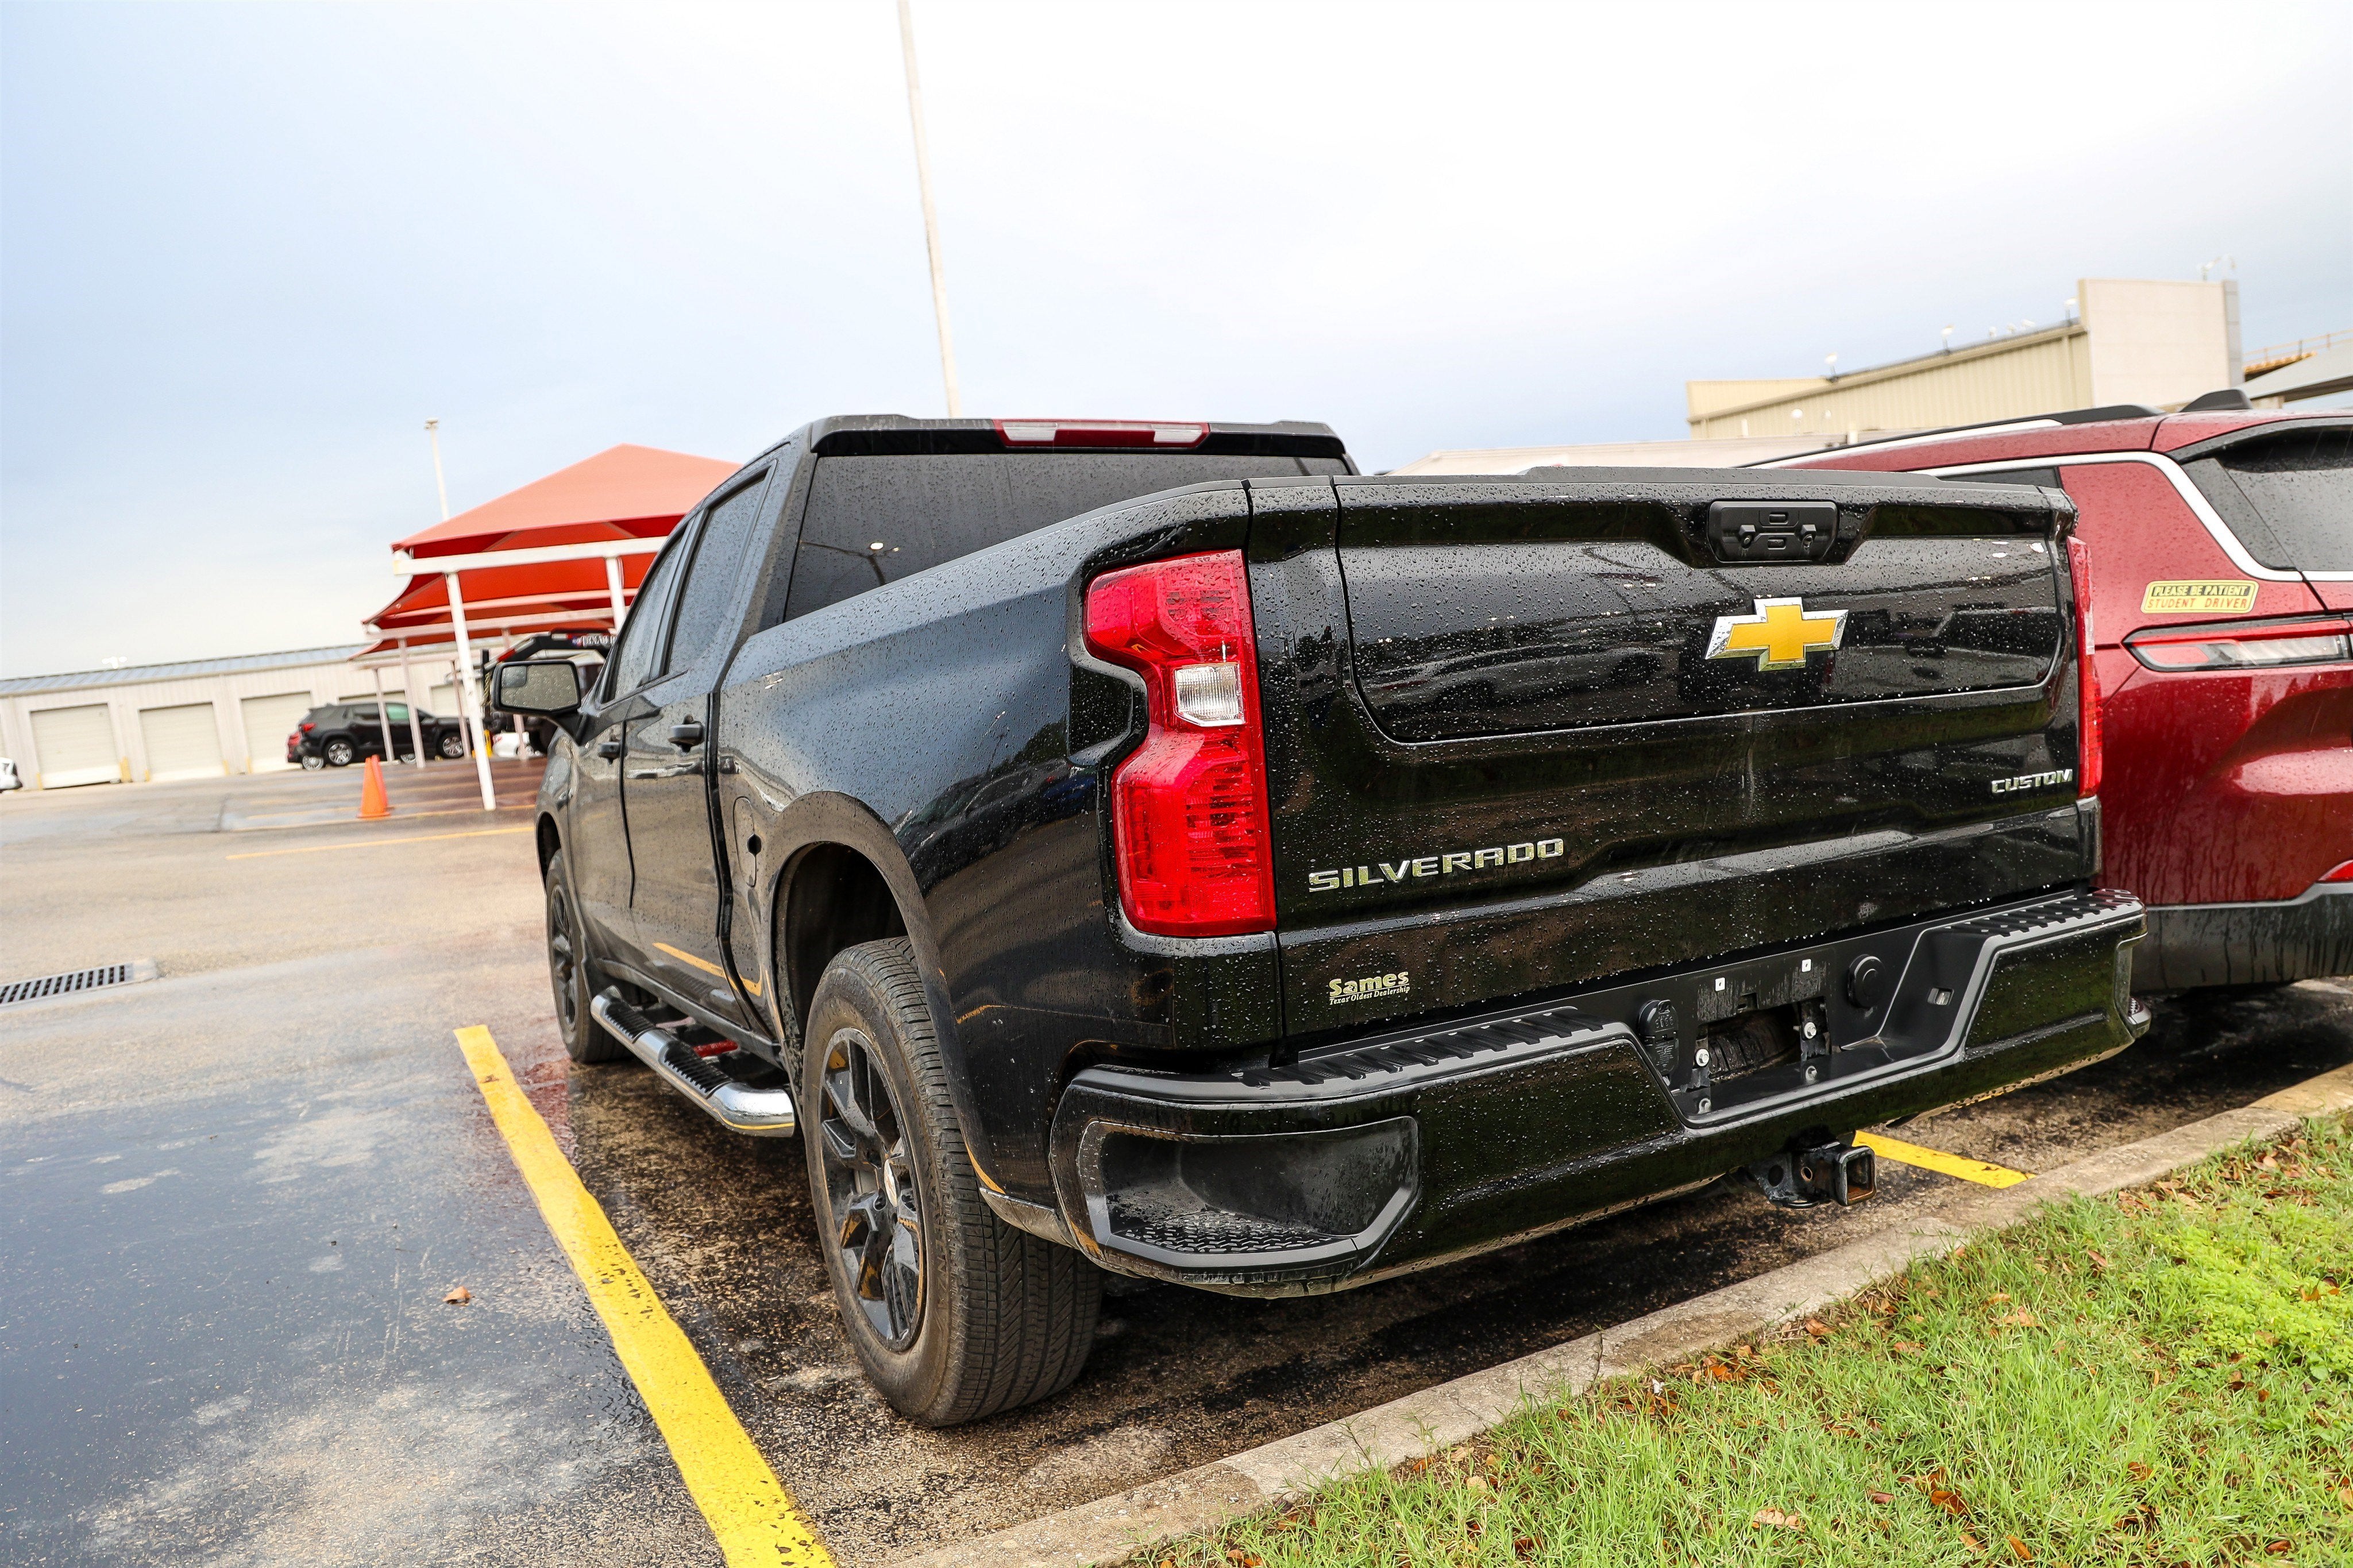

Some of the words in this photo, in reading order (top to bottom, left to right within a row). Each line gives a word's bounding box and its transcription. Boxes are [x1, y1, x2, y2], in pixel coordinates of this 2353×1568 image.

[2153, 585, 2189, 596] PLEASE
[2189, 585, 2204, 596] BE
[2204, 585, 2248, 596] PATIENT
[2147, 598, 2196, 608] STUDENT
[2204, 598, 2247, 608] DRIVER
[1991, 768, 2073, 794] CUSTOM
[1308, 837, 1564, 893] SILVERADO
[1329, 971, 1409, 997] Sames
[1351, 992, 1372, 1001] Oldest
[1374, 986, 1410, 998] Dealership
